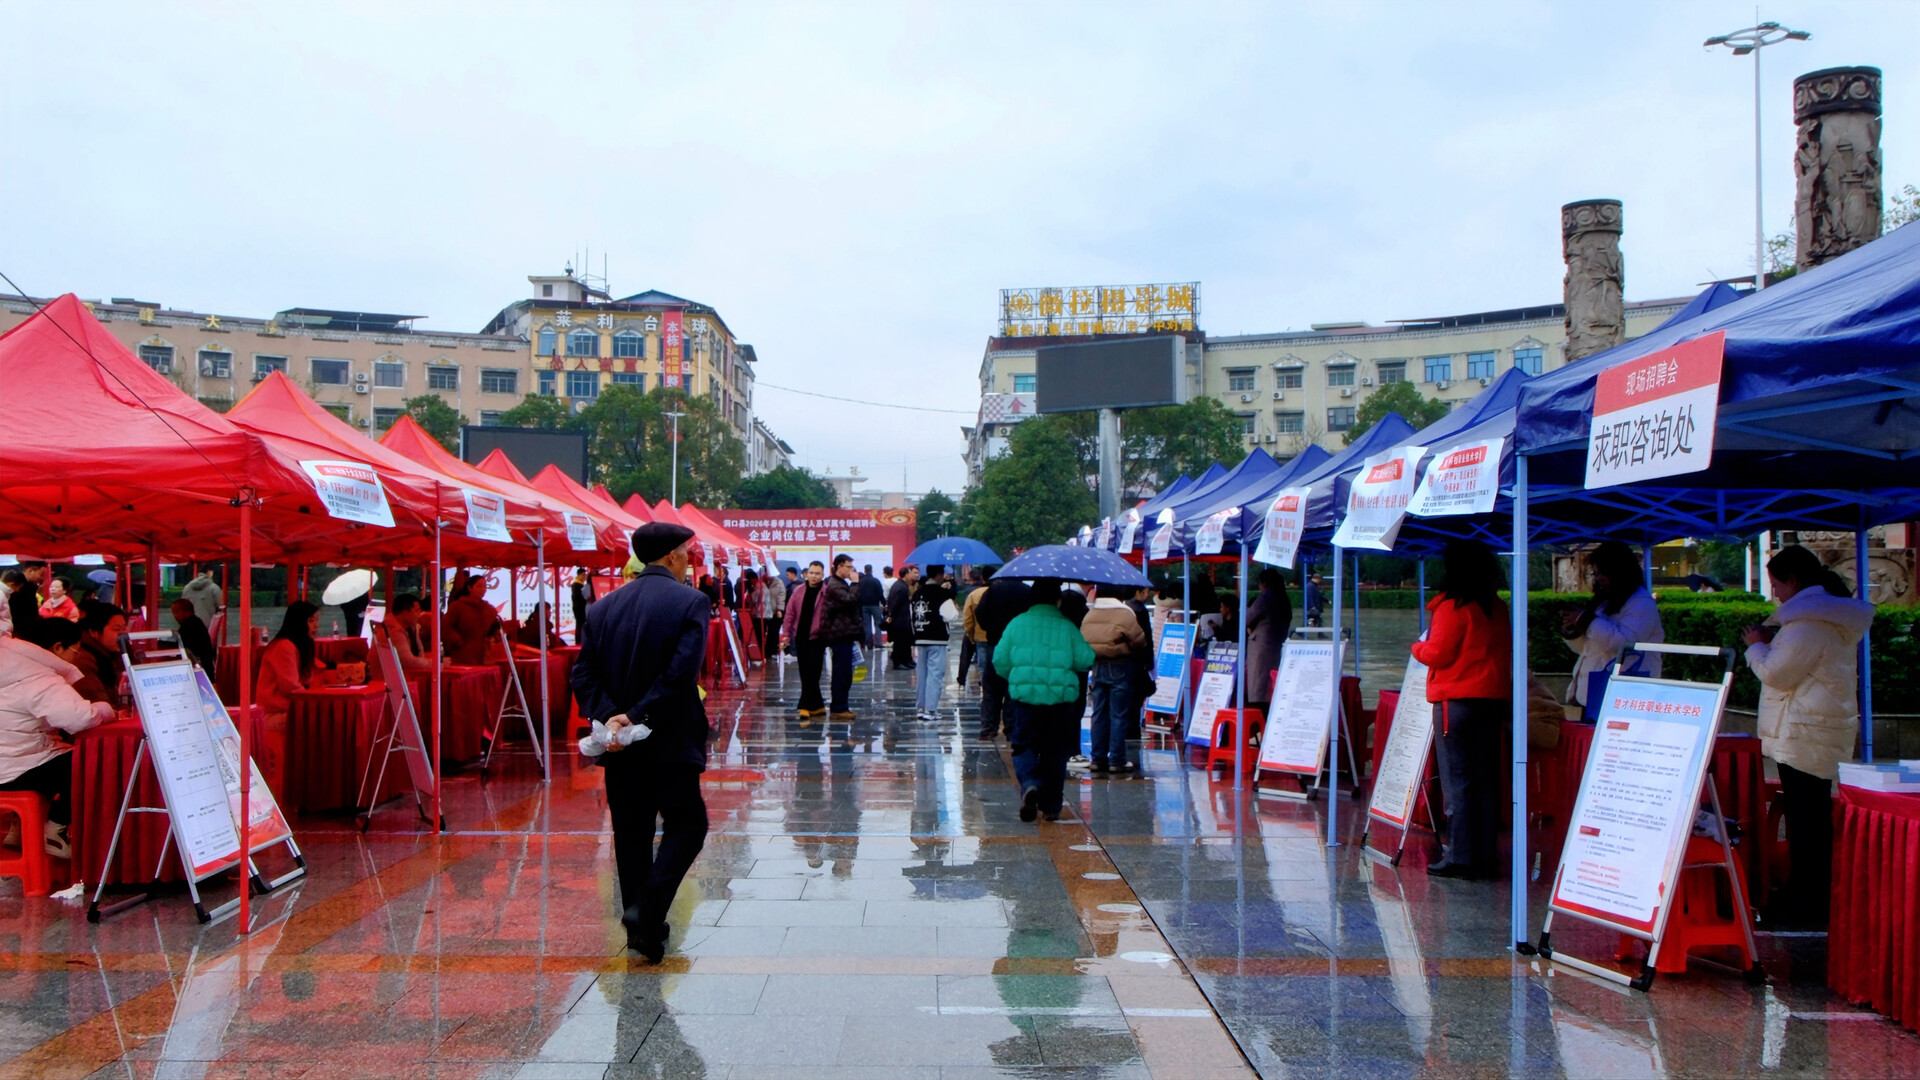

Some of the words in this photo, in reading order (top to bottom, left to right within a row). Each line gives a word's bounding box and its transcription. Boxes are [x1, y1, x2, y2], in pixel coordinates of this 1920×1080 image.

[1625, 357, 1679, 396] 现场招聘会
[1593, 403, 1696, 473] 求职咨询处
[748, 530, 851, 542] 企业岗位信息一览表
